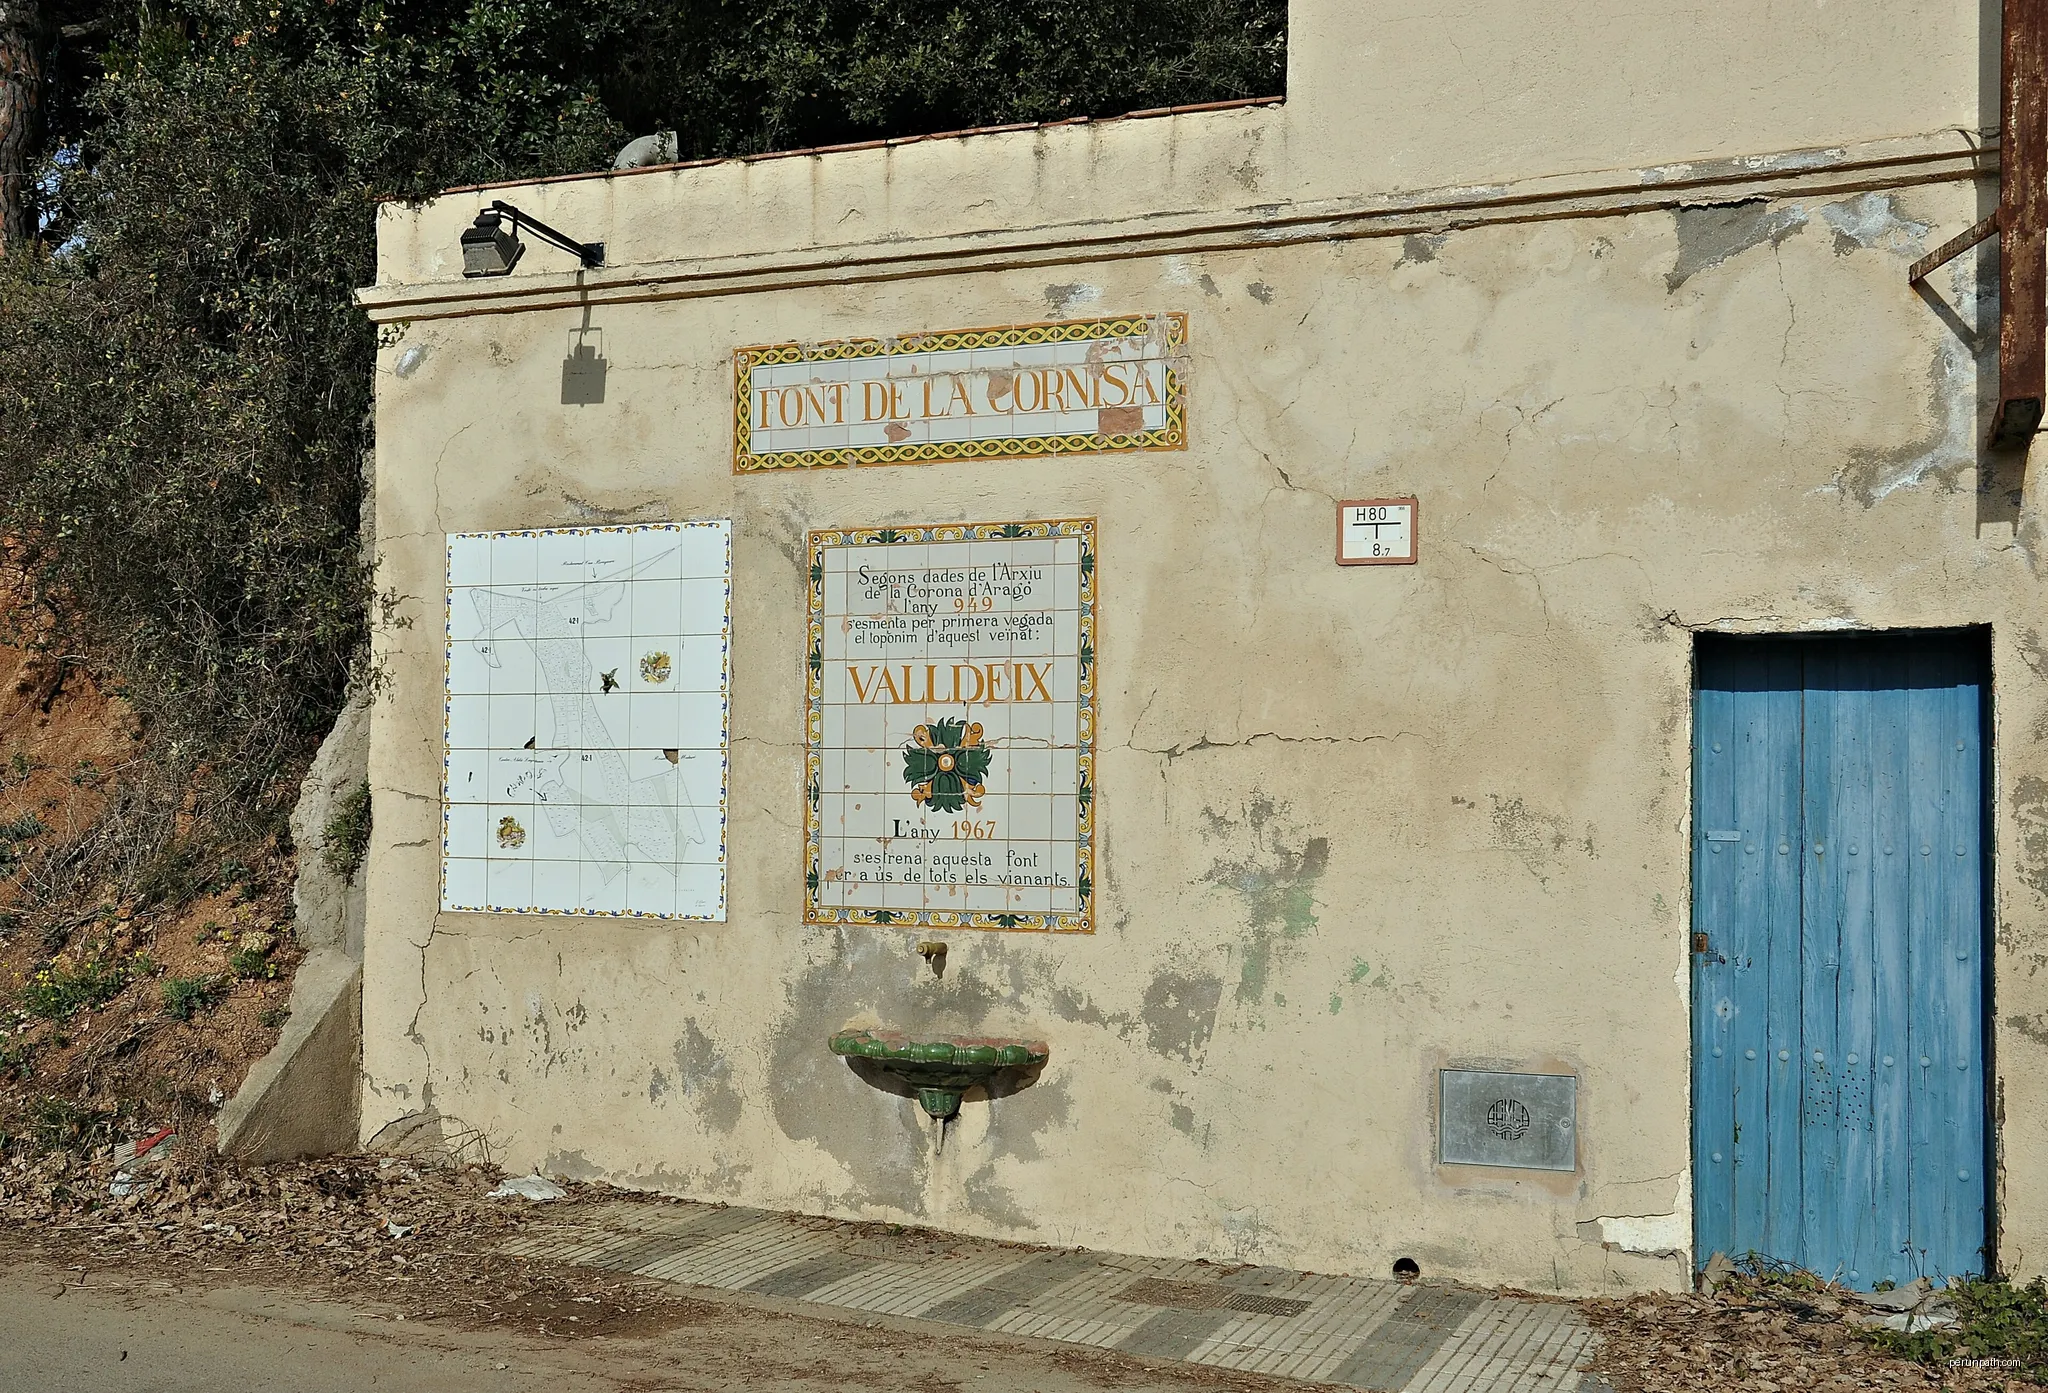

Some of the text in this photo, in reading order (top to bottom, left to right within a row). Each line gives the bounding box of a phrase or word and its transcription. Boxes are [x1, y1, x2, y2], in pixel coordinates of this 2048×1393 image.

[759, 383, 849, 428] FONT
[862, 381, 910, 422] DE
[920, 377, 977, 418] LA
[1356, 507, 1387, 521] H80
[1373, 543, 1390, 556] 8.7
[858, 562, 1042, 590] Segons dades de l'Arxiu
[865, 581, 1032, 600] de la Corona d'Aragó
[904, 597, 993, 616] l'any 949
[847, 612, 1053, 632] s'esmenta per primera vegada
[855, 631, 866, 644] el
[926, 630, 980, 646] d'aquest
[847, 662, 1053, 704] VALLDEIX
[893, 820, 996, 844] L'any 1967
[854, 850, 1038, 872] s'estrena aquesta font
[860, 870, 868, 882] a
[875, 866, 893, 882] ús
[904, 868, 922, 883] de
[929, 868, 956, 884] tots
[966, 868, 988, 884] els
[998, 867, 1070, 887] vianants.
